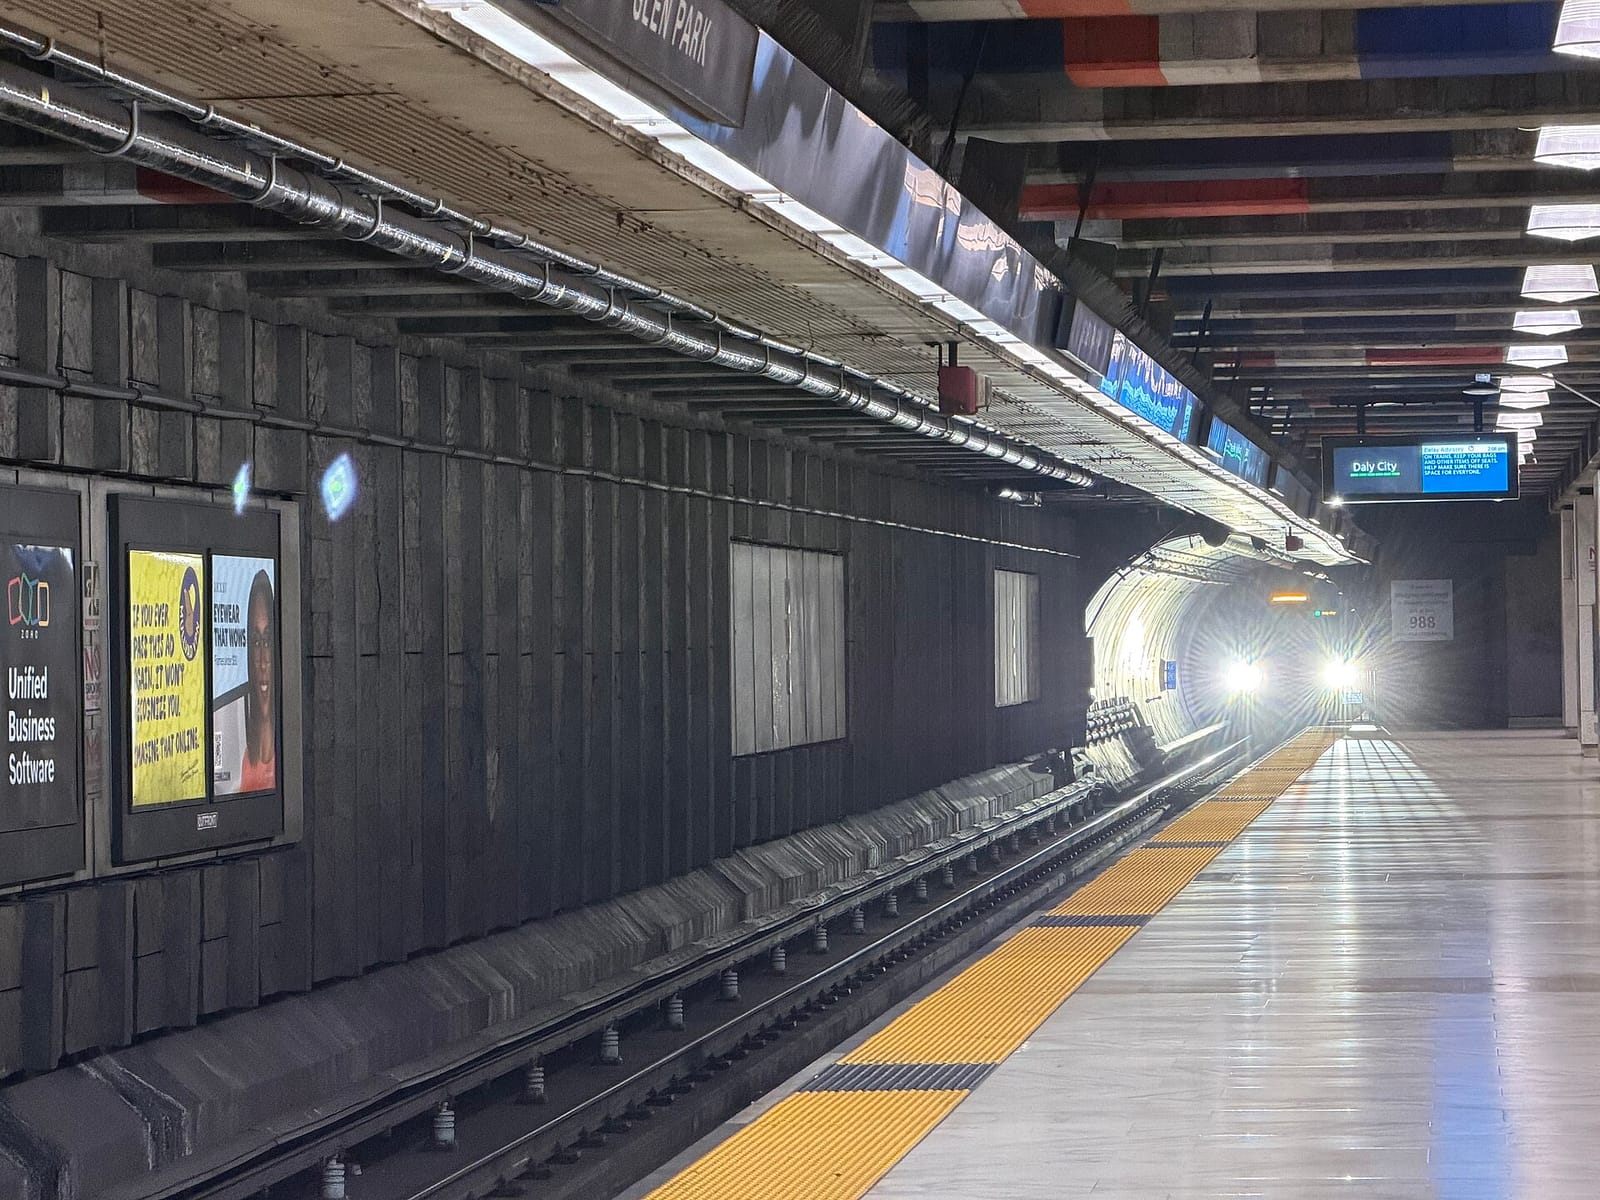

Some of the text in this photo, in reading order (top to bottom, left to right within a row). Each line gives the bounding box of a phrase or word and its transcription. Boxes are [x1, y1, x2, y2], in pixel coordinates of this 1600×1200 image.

[672, 0, 712, 67] PARK
[1353, 461, 1397, 473] Daly City
[133, 603, 169, 629] IF YOU EVER
[214, 603, 240, 623] EYEWEAR
[1410, 616, 1435, 629] 988
[150, 633, 163, 658] THIS
[165, 633, 174, 657] AD
[214, 627, 246, 648] THAT WOWS
[8, 666, 48, 699] Unified
[156, 665, 163, 689] IT
[165, 663, 184, 687] WON'T
[136, 694, 180, 722] ECOGNIZE YOU.
[8, 709, 55, 741] Business
[160, 734, 174, 759] THAT
[176, 727, 199, 753] ONLINE.
[8, 751, 55, 784] Software
